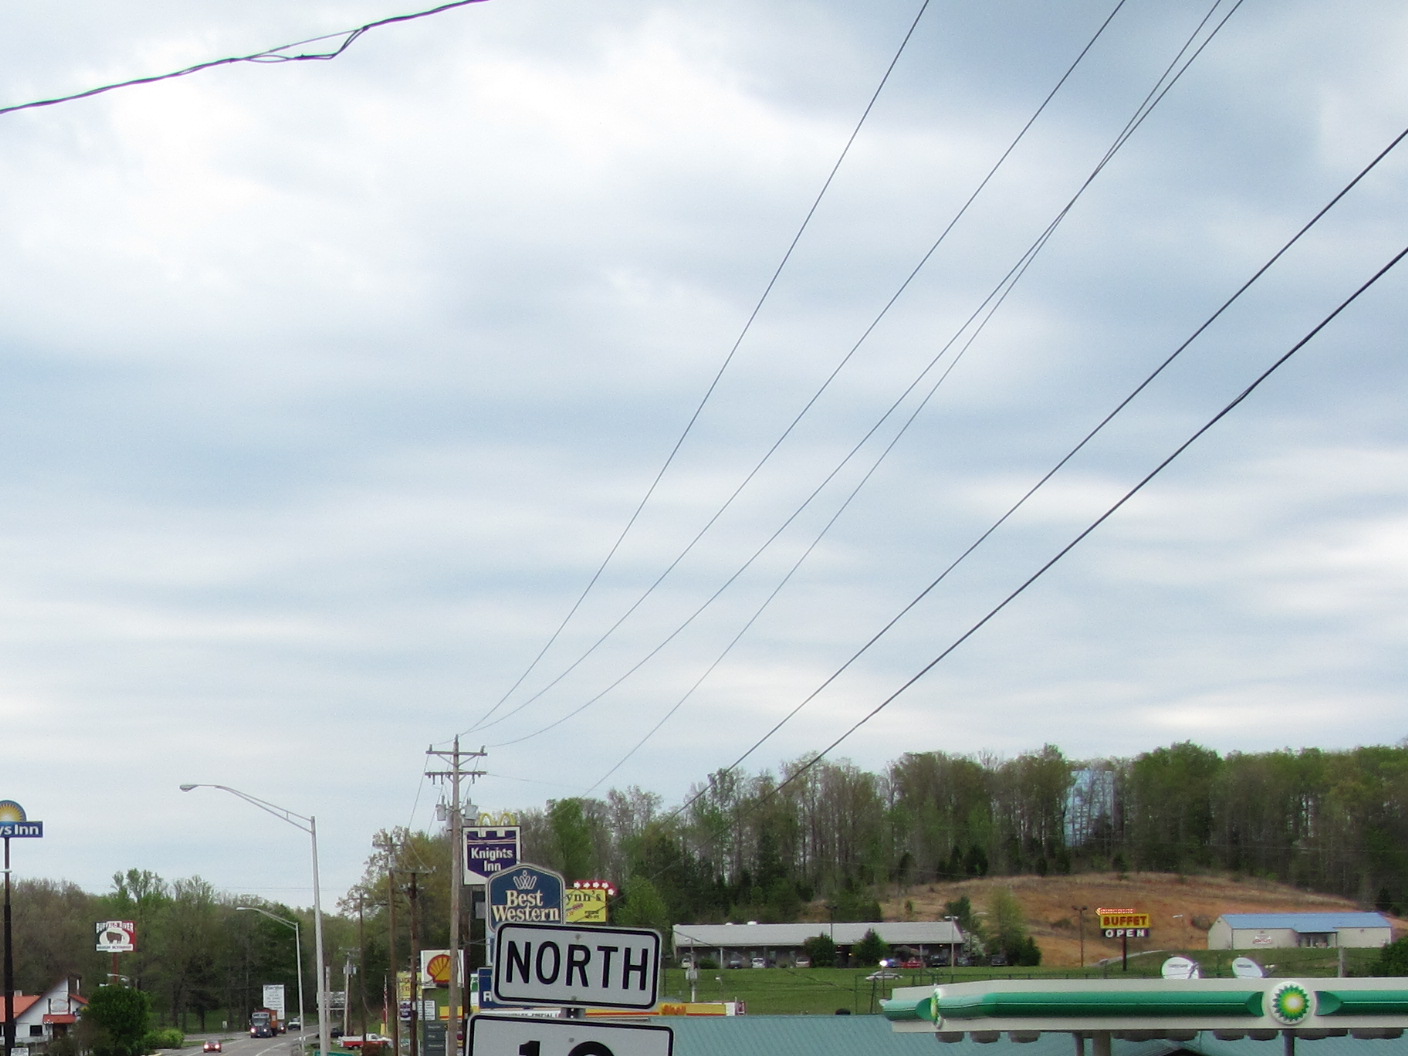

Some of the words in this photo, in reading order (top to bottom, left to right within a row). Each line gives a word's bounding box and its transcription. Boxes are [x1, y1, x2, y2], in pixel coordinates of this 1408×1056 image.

[14, 824, 39, 835] Inn
[471, 847, 513, 860] Knights
[484, 860, 501, 872] Inn
[505, 890, 543, 907] Best
[565, 890, 602, 905] ynn's
[492, 904, 561, 922] Western
[1103, 916, 1147, 926] BUFFET
[1105, 929, 1145, 938] OPEN
[506, 940, 649, 991] NORTH
